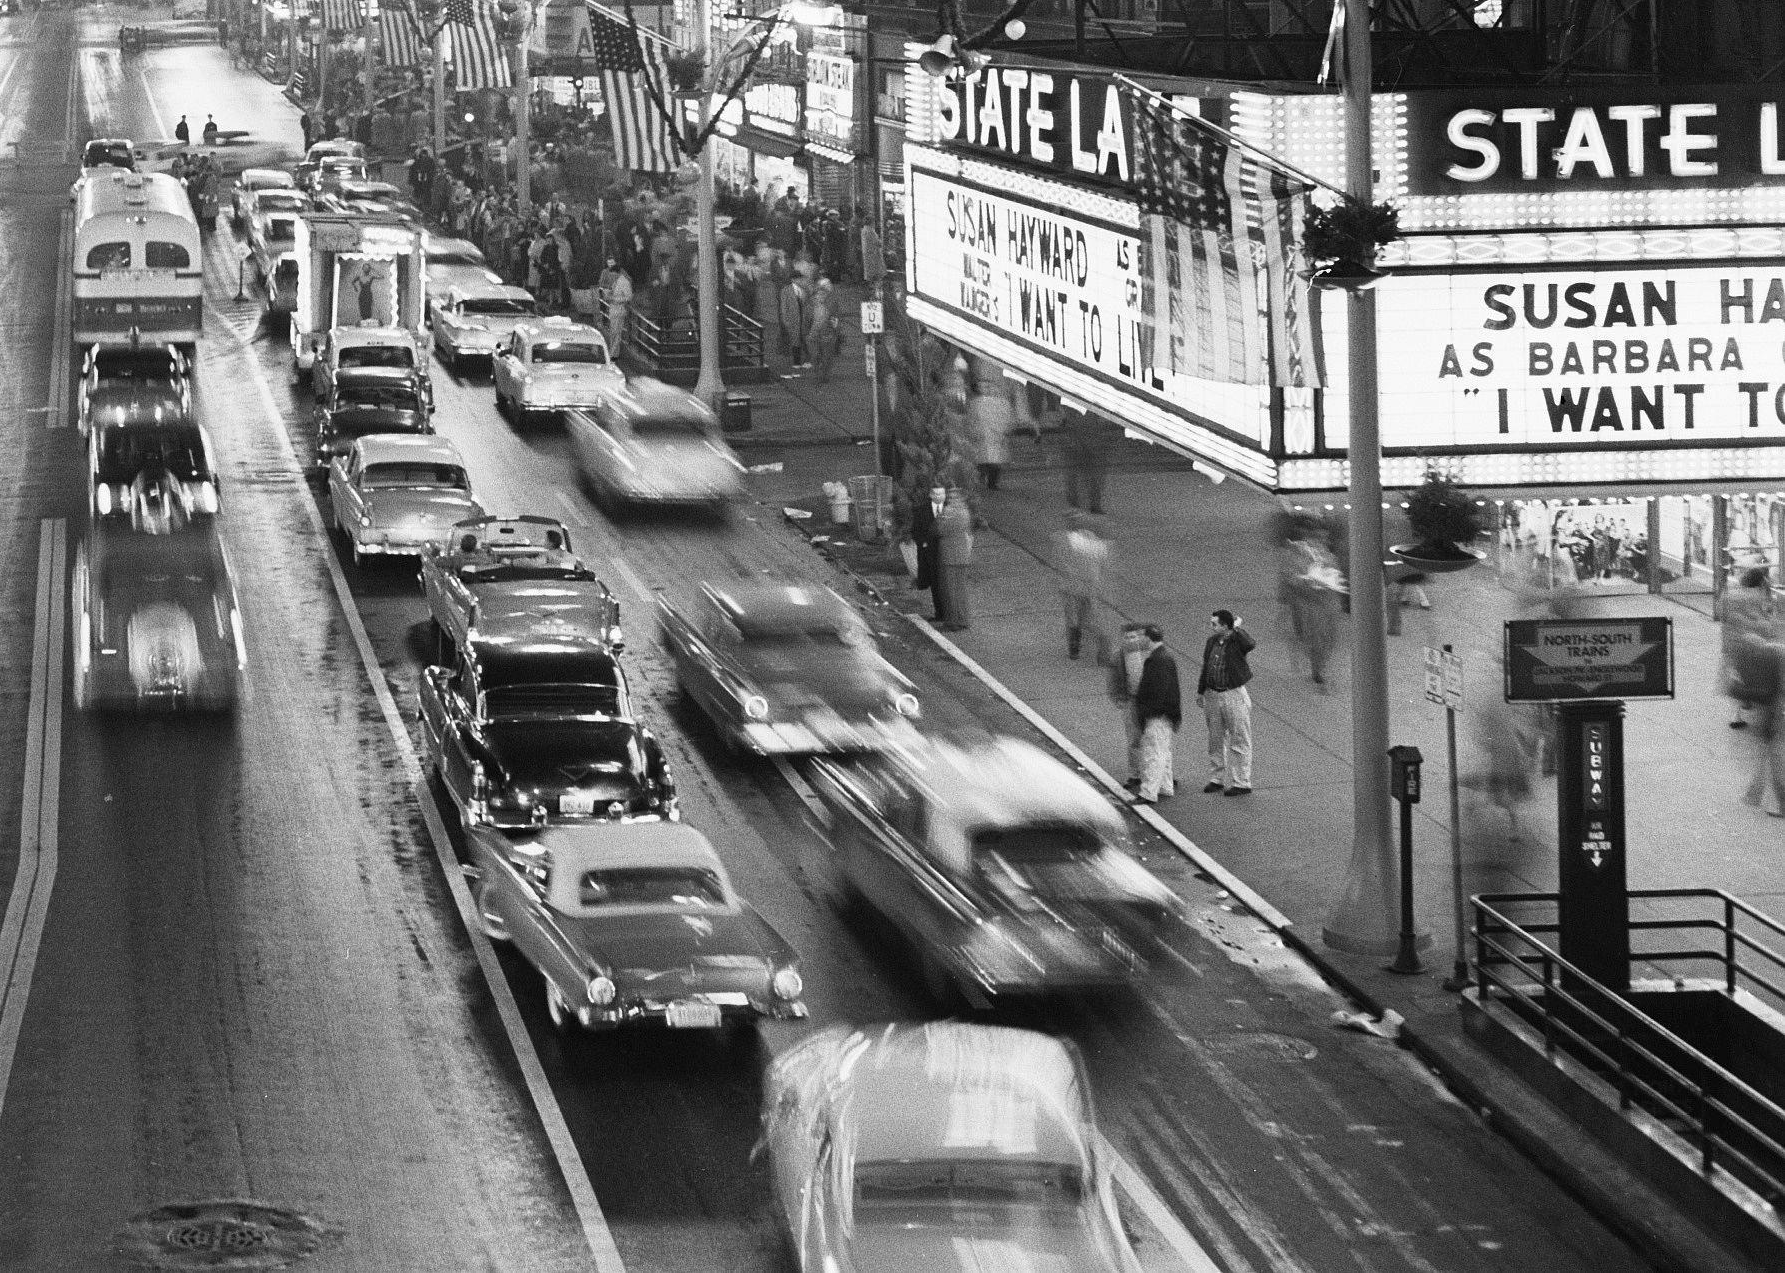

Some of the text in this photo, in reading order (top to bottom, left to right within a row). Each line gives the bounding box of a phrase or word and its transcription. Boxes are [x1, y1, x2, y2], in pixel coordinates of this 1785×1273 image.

[938, 65, 1055, 164] STATE
[1445, 102, 1718, 182] STATE
[947, 190, 997, 257] SUSAN
[1008, 208, 1088, 288] HAYWARD
[1019, 276, 1067, 349] WANT
[1079, 299, 1102, 363] TO
[1483, 280, 1677, 331] SUSAN
[1438, 336, 1744, 379] AS BARBARA
[1542, 384, 1705, 433] WANT
[1544, 633, 1633, 646] NORTH-SOUTH
[1567, 646, 1611, 658] TRAINS
[1589, 728, 1604, 808] SUBWAY
